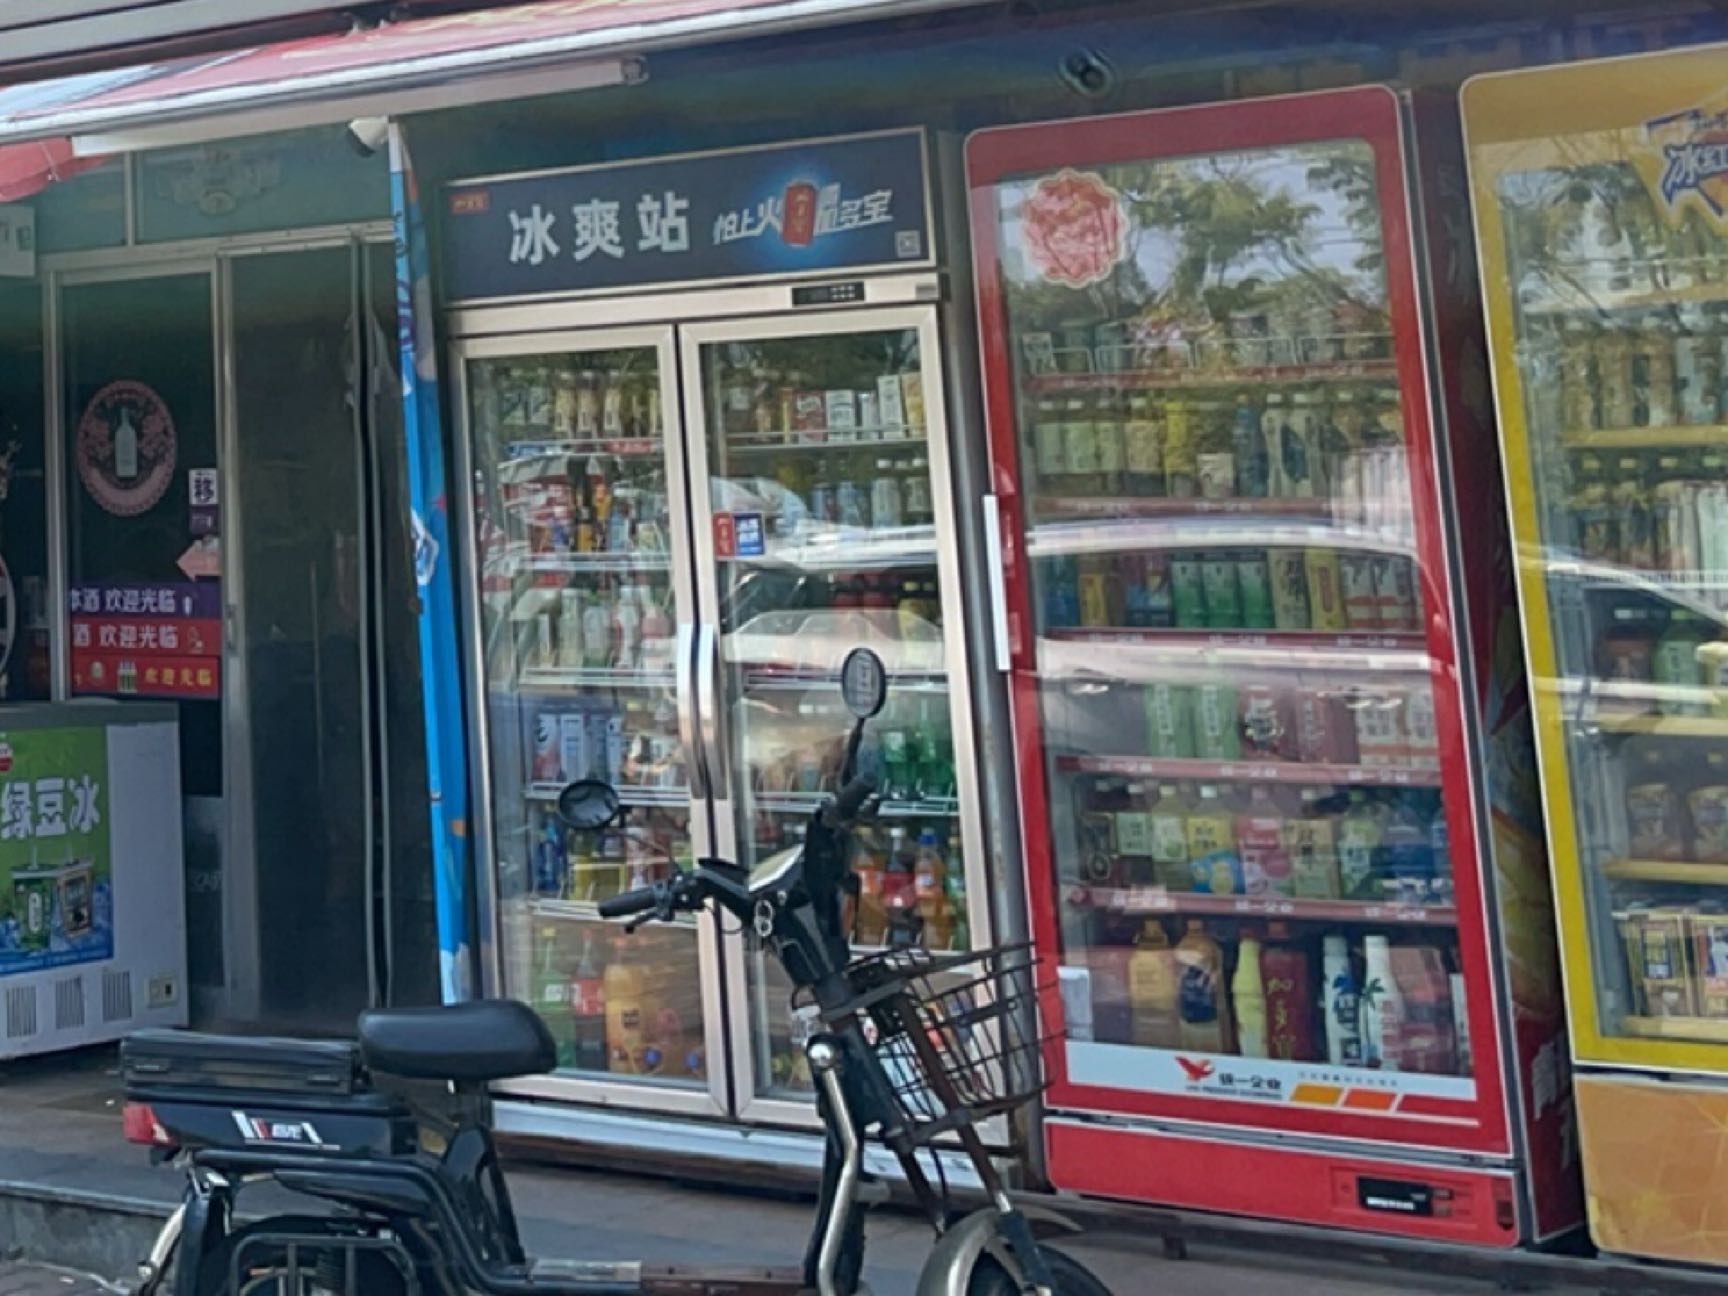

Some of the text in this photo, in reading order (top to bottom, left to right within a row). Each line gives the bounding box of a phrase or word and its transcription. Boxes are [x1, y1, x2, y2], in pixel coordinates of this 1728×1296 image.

[508, 191, 690, 266] 冰爽站
[0, 774, 101, 841] 绿豆冰
